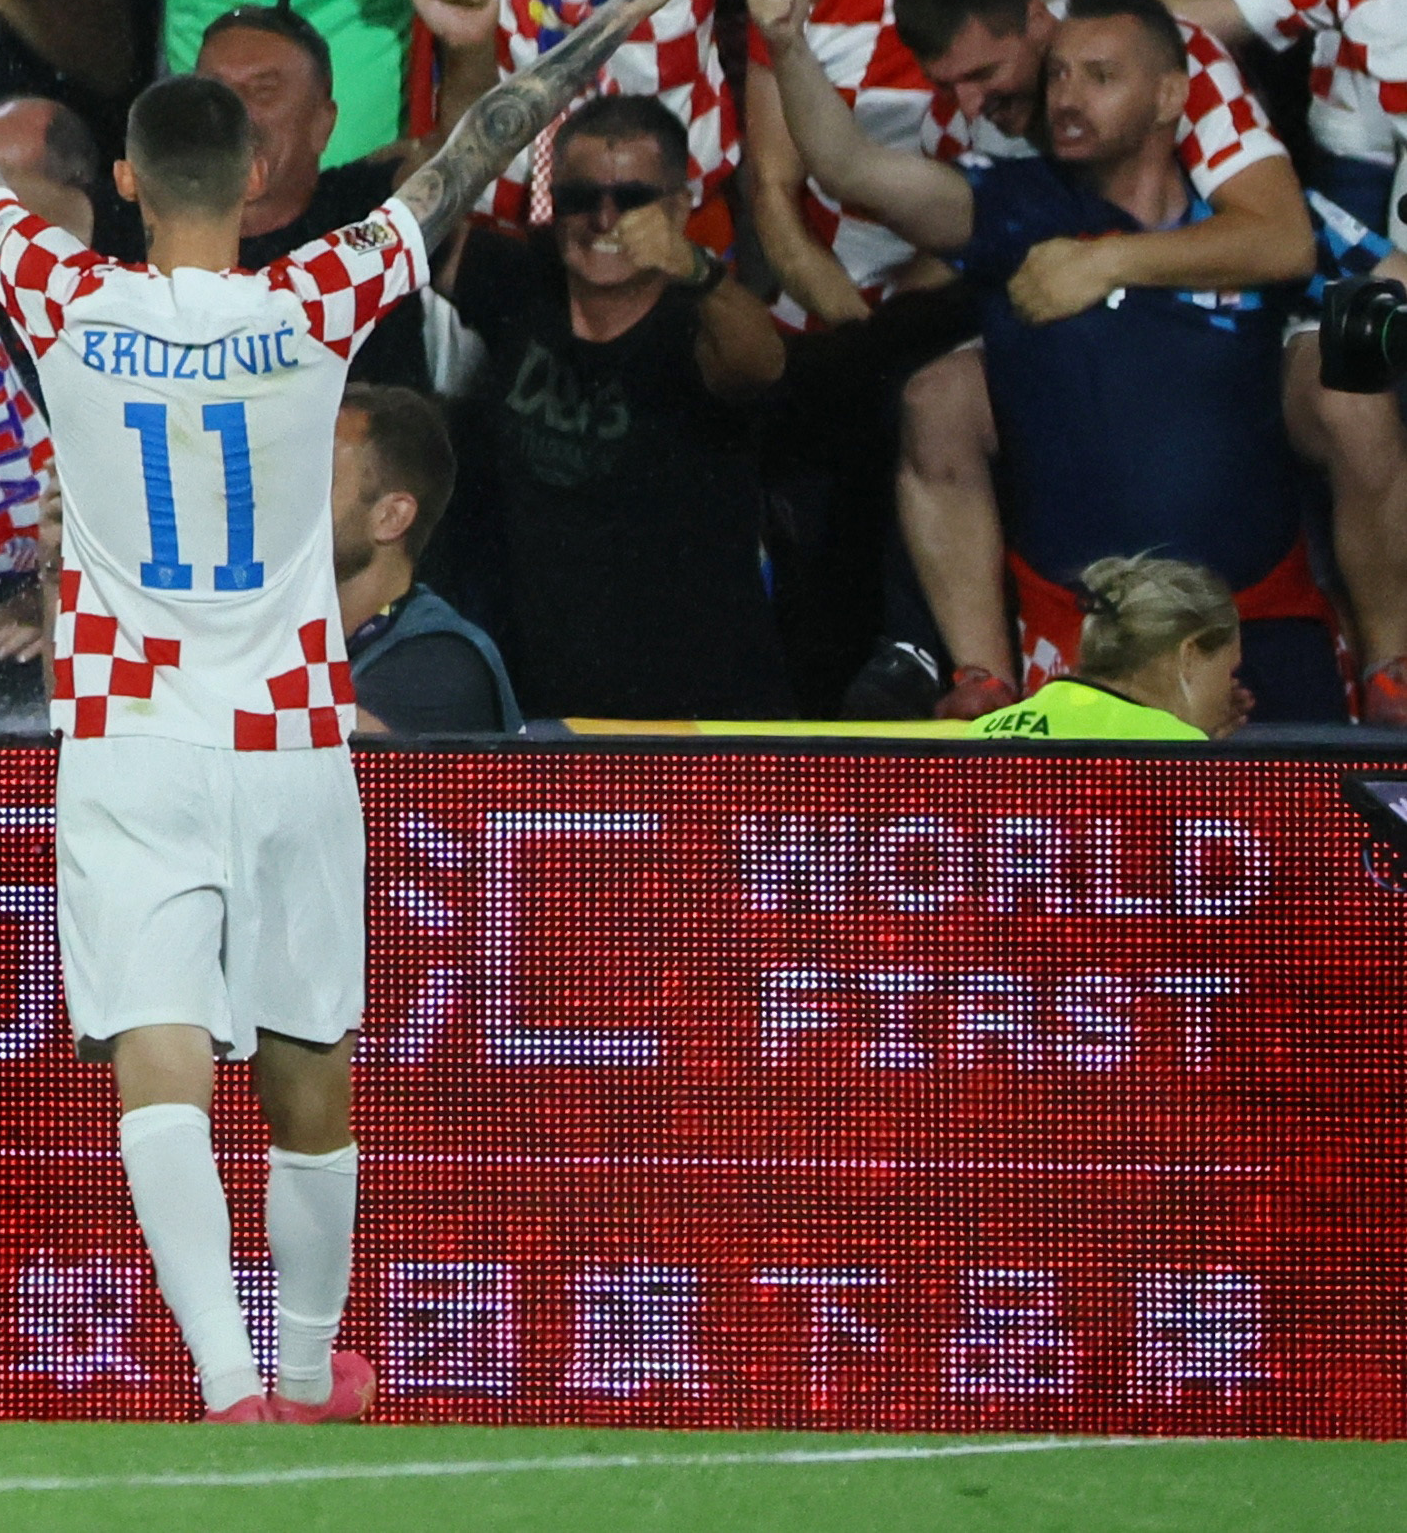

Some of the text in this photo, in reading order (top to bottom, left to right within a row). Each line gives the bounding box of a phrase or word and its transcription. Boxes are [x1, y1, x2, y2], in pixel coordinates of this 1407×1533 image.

[82, 323, 300, 381] BROZOVIĆ
[124, 401, 265, 593] 11
[984, 710, 1050, 736] UEFA
[739, 814, 1271, 915] WORLD
[760, 968, 1243, 1073] FIRST
